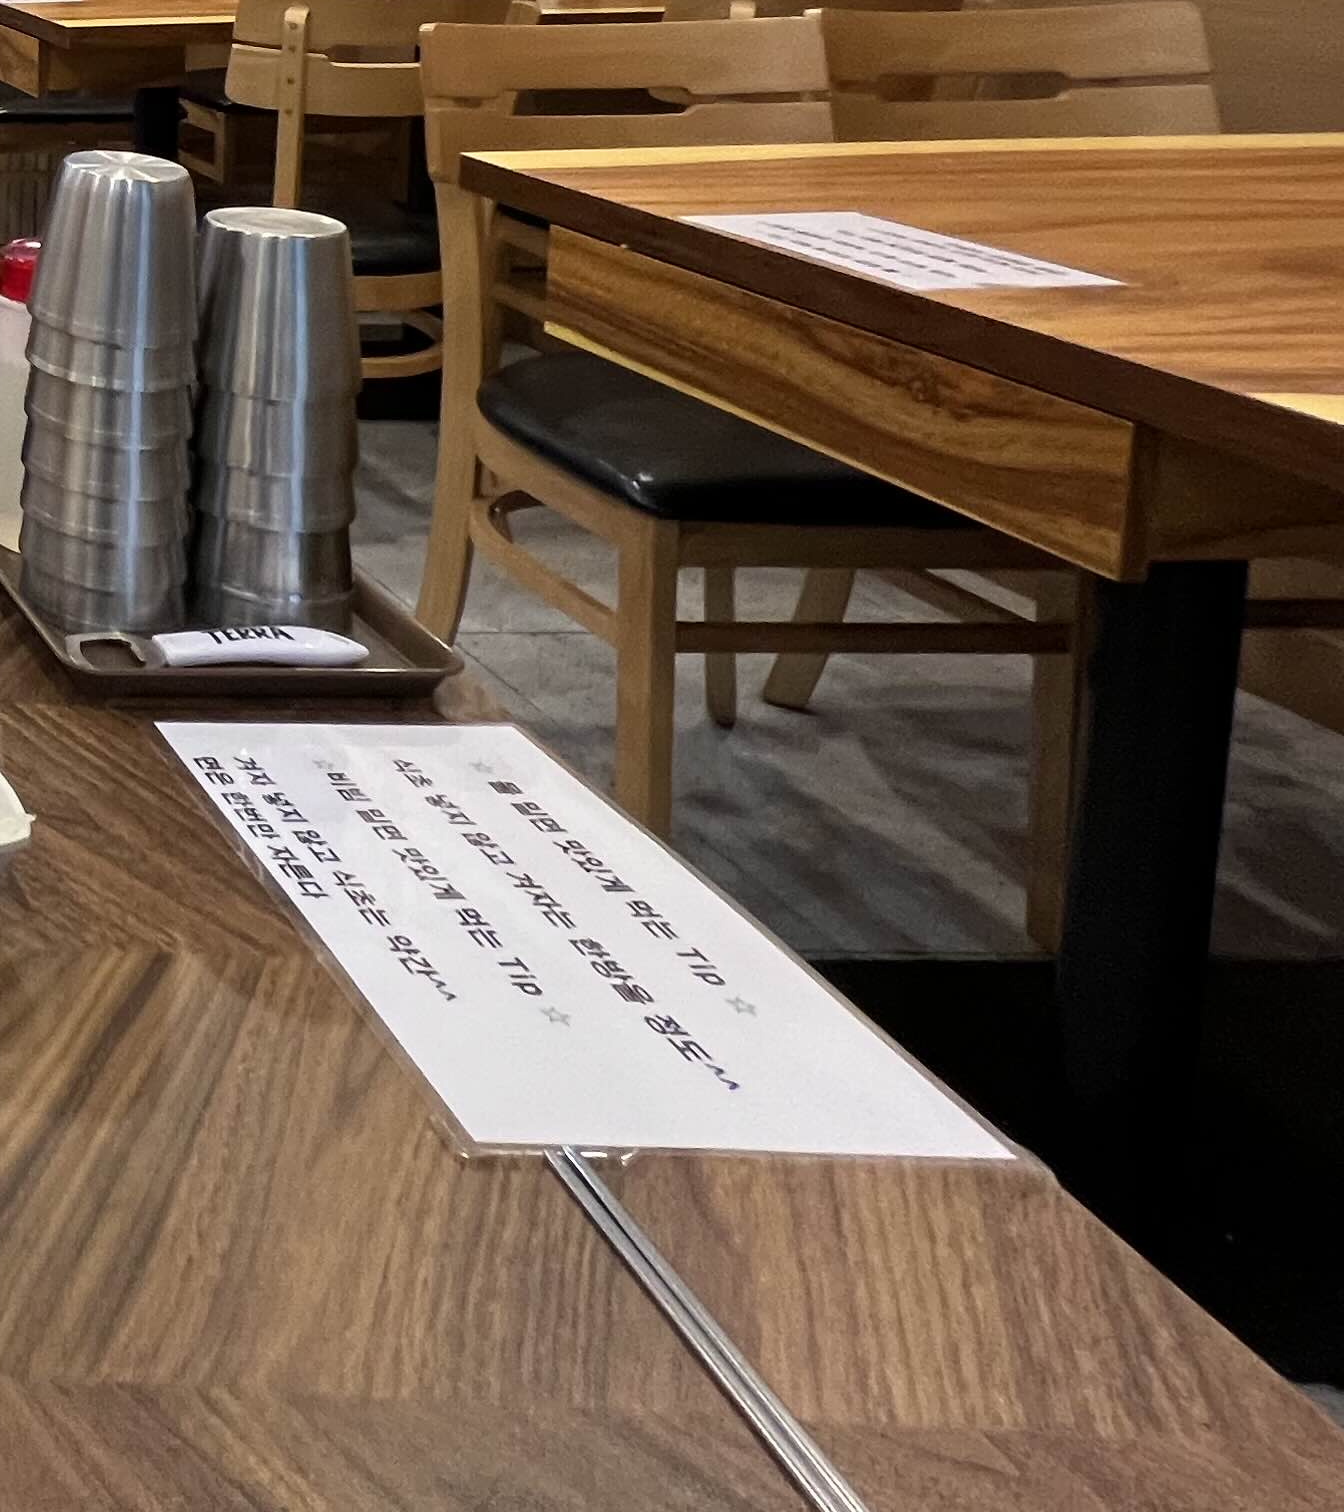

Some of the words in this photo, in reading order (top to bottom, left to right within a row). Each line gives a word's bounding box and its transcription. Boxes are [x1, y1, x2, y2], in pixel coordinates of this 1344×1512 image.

[202, 626, 294, 645] TERRA
[194, 756, 234, 785] 면은
[221, 791, 281, 839] 한번만
[267, 845, 329, 899] 자른다
[233, 756, 276, 786] 겨자
[262, 792, 309, 822] 넣지
[293, 829, 341, 863] 않고
[333, 870, 391, 927] 식초는
[328, 772, 372, 802] 비빔
[355, 809, 408, 840] 밀면
[392, 848, 466, 900] 맛있게
[456, 908, 503, 948] 먹는
[498, 957, 543, 996] Tip
[393, 759, 433, 787] 식초
[425, 794, 477, 825] 넣지
[462, 832, 514, 865] 않고
[506, 873, 576, 929] 겨자는
[511, 801, 567, 833] 밀면
[553, 840, 635, 894] 맛있게
[626, 900, 679, 940] 먹는
[676, 947, 726, 986] Tip
